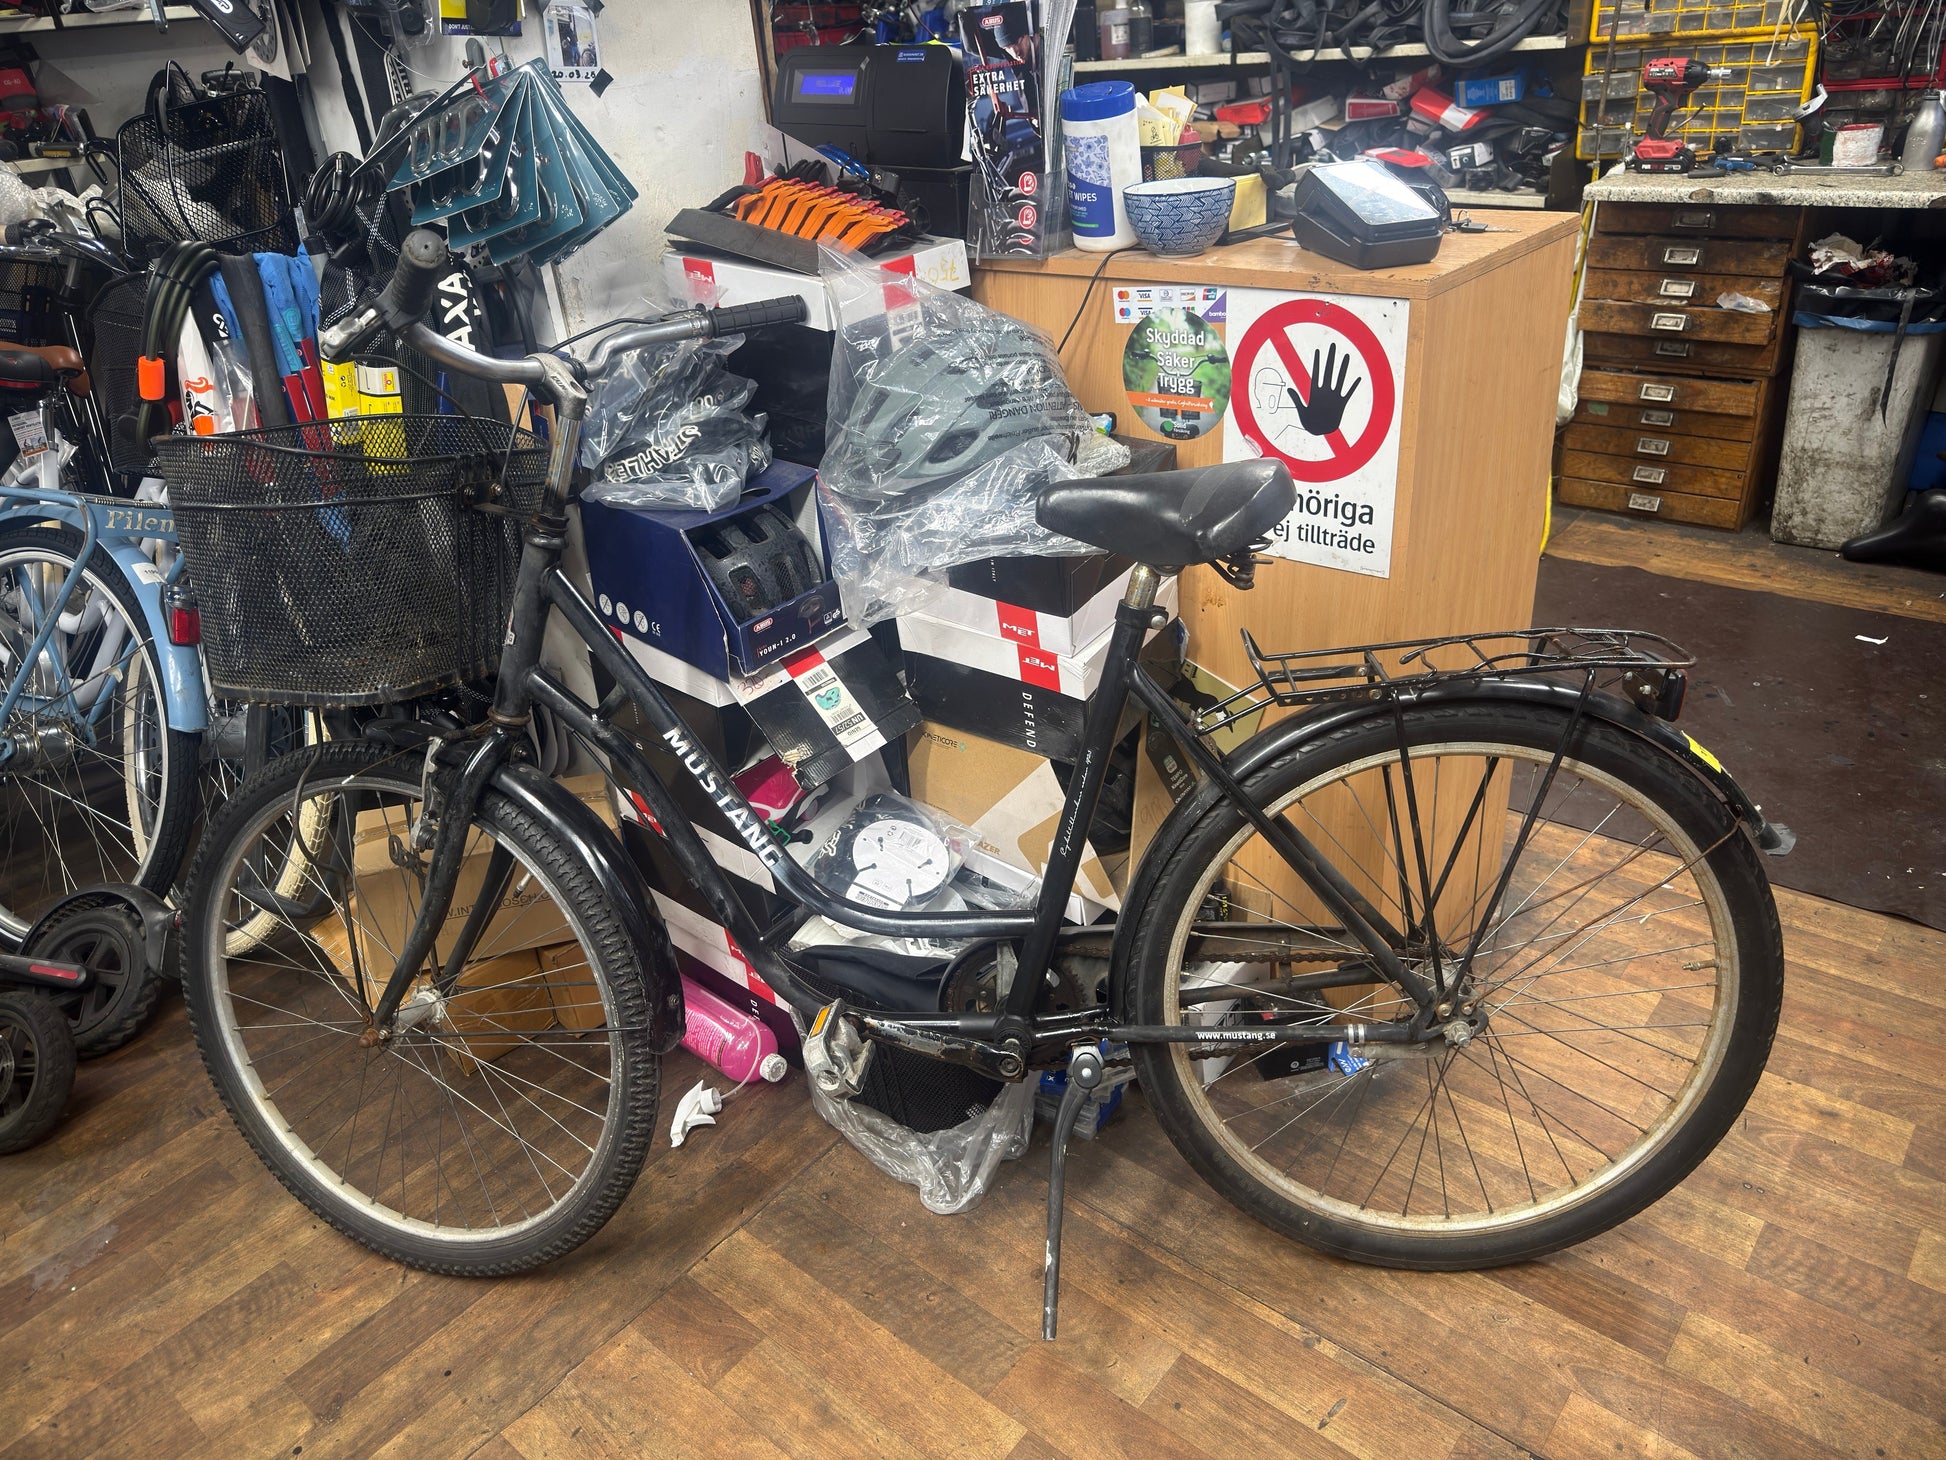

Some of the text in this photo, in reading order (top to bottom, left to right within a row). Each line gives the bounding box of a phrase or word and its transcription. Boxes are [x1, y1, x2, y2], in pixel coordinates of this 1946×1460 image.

[983, 17, 1001, 25] ABUS
[973, 70, 1005, 84] EXTRA
[974, 80, 1025, 97] SÄKERHET
[1074, 192, 1097, 202] WIPES
[438, 272, 476, 352] AXA
[1146, 328, 1204, 348] Skyddad
[1157, 351, 1195, 368] Säker
[1158, 373, 1194, 394] Trygg
[988, 404, 1029, 421] DANGER!
[105, 509, 175, 533] Pilen
[1273, 520, 1375, 554] ej tillträde
[1002, 622, 1036, 637] MET
[785, 633, 797, 644] 2.0
[1022, 656, 1055, 672] MET
[834, 713, 864, 734] UN 52/57
[1022, 692, 1036, 748] DEFEND
[922, 732, 958, 748] KINETICORE
[662, 724, 783, 868] MUSTANG
[977, 841, 1001, 855] AZER
[1196, 1031, 1277, 1041] www.mustang.se
